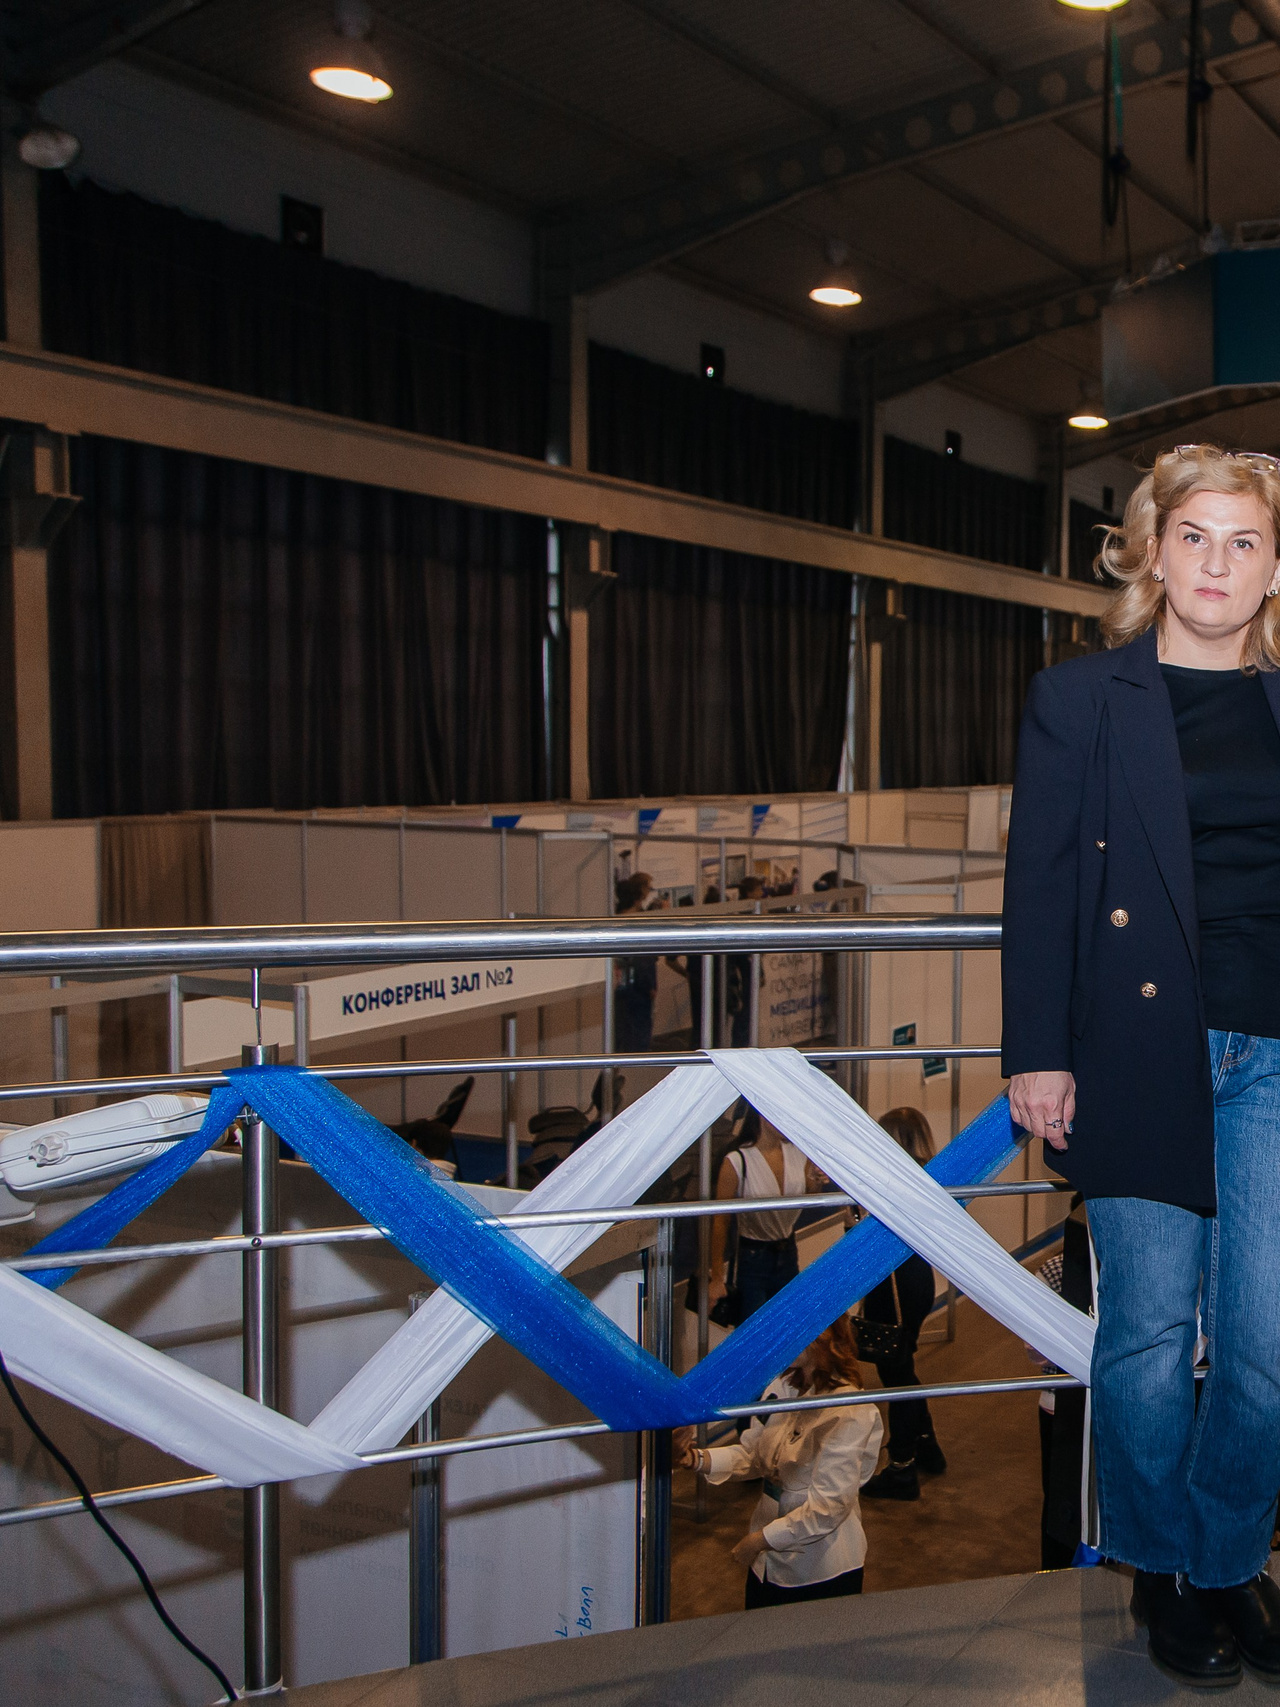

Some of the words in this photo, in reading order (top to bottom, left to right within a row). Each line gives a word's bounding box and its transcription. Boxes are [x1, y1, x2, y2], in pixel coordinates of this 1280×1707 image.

[342, 978, 446, 1015] КОНФЕРЕНЦ
[451, 972, 481, 995] ЗАЛ
[486, 966, 513, 988] №2
